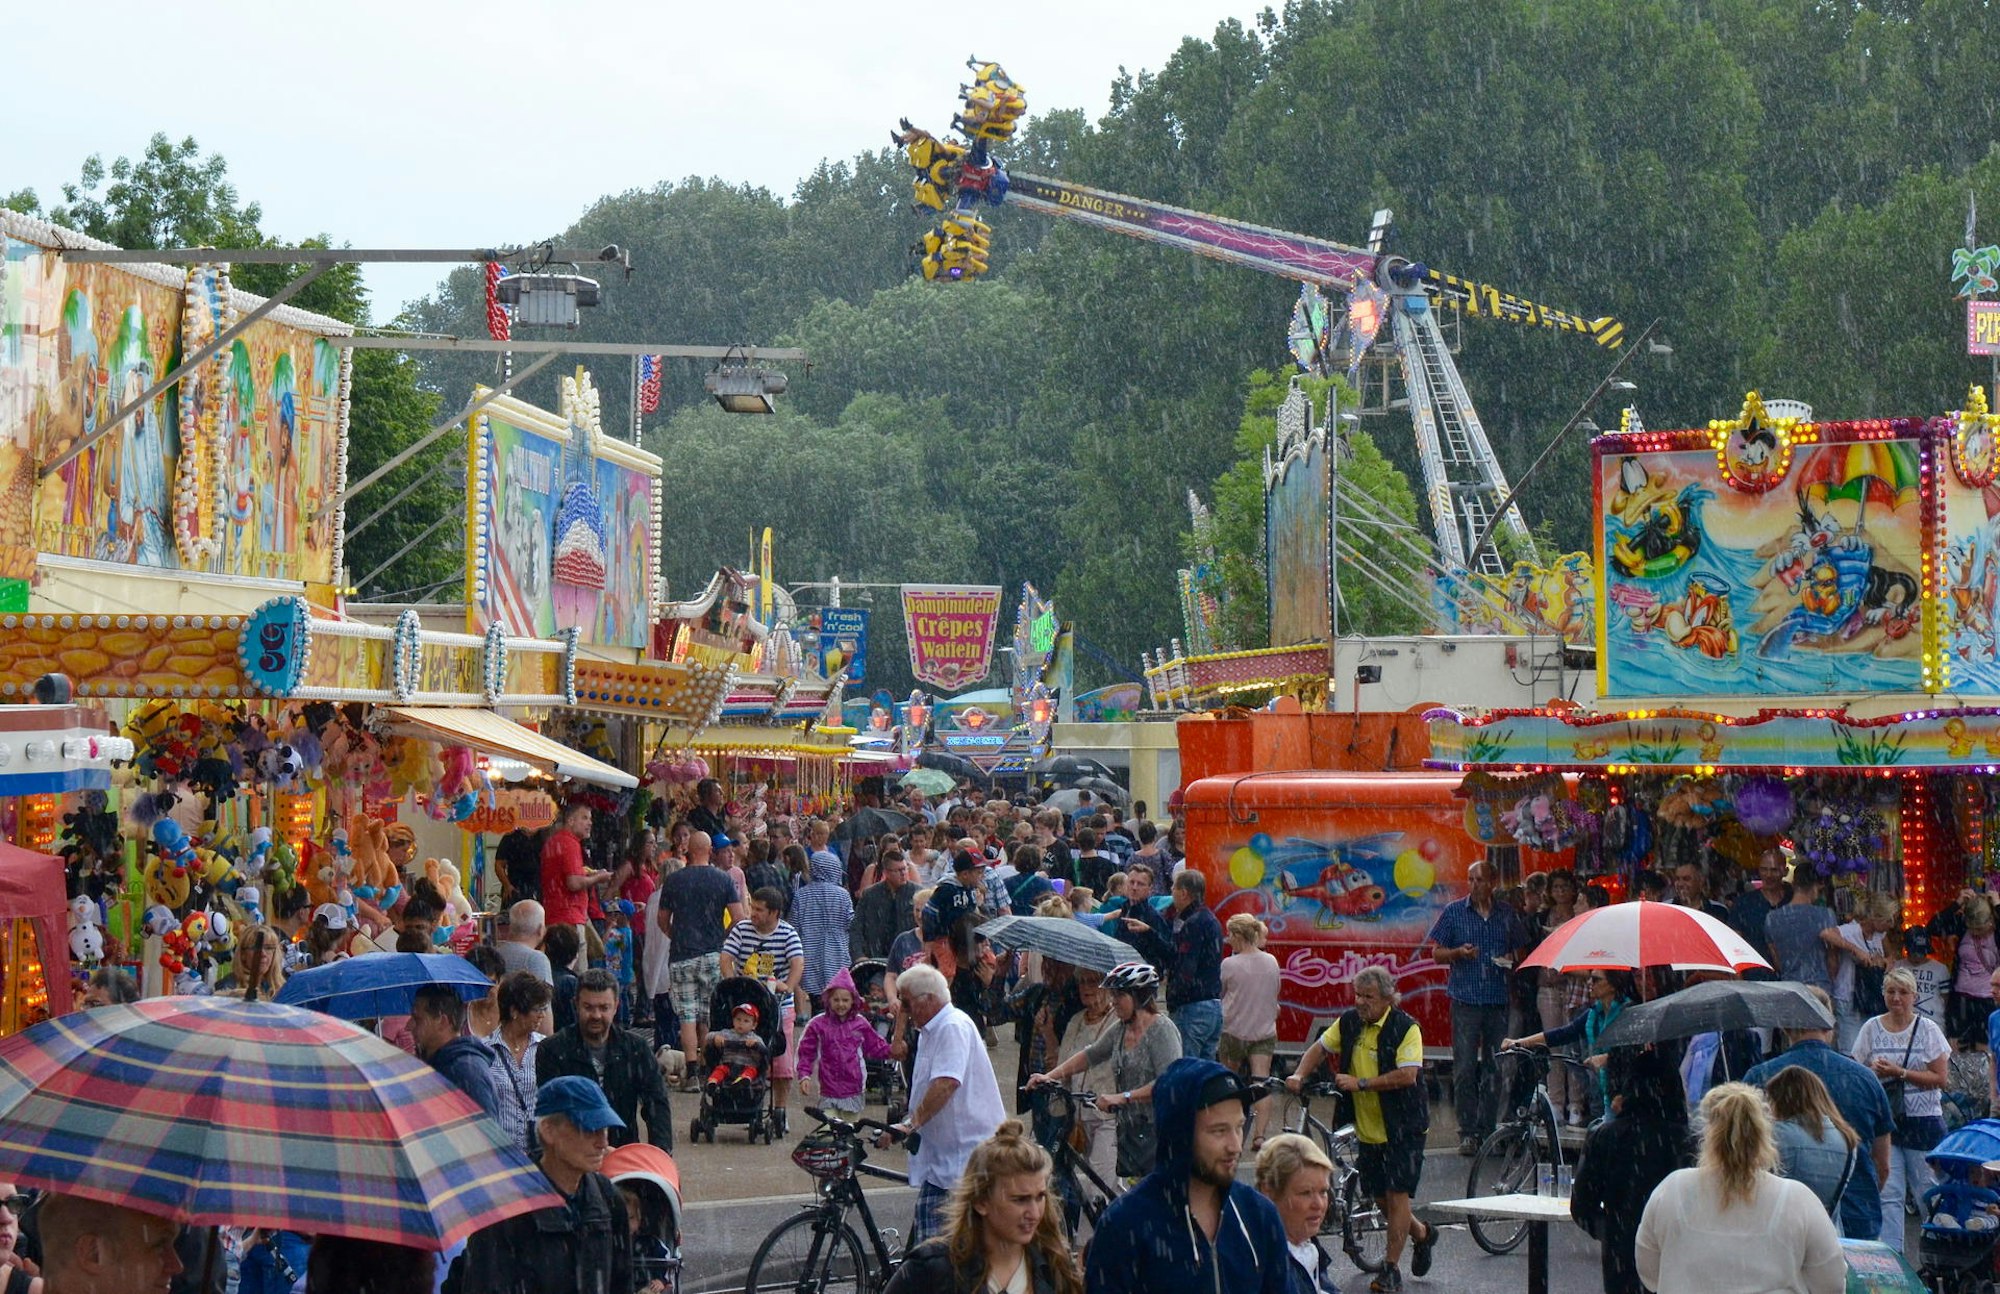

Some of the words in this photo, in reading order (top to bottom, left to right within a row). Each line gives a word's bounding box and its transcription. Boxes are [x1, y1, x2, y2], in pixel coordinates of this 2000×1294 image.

[1059, 190, 1124, 217] DANGER
[828, 611, 861, 621] fresh
[918, 617, 983, 640] Crêpes
[921, 641, 980, 659] Waffeln
